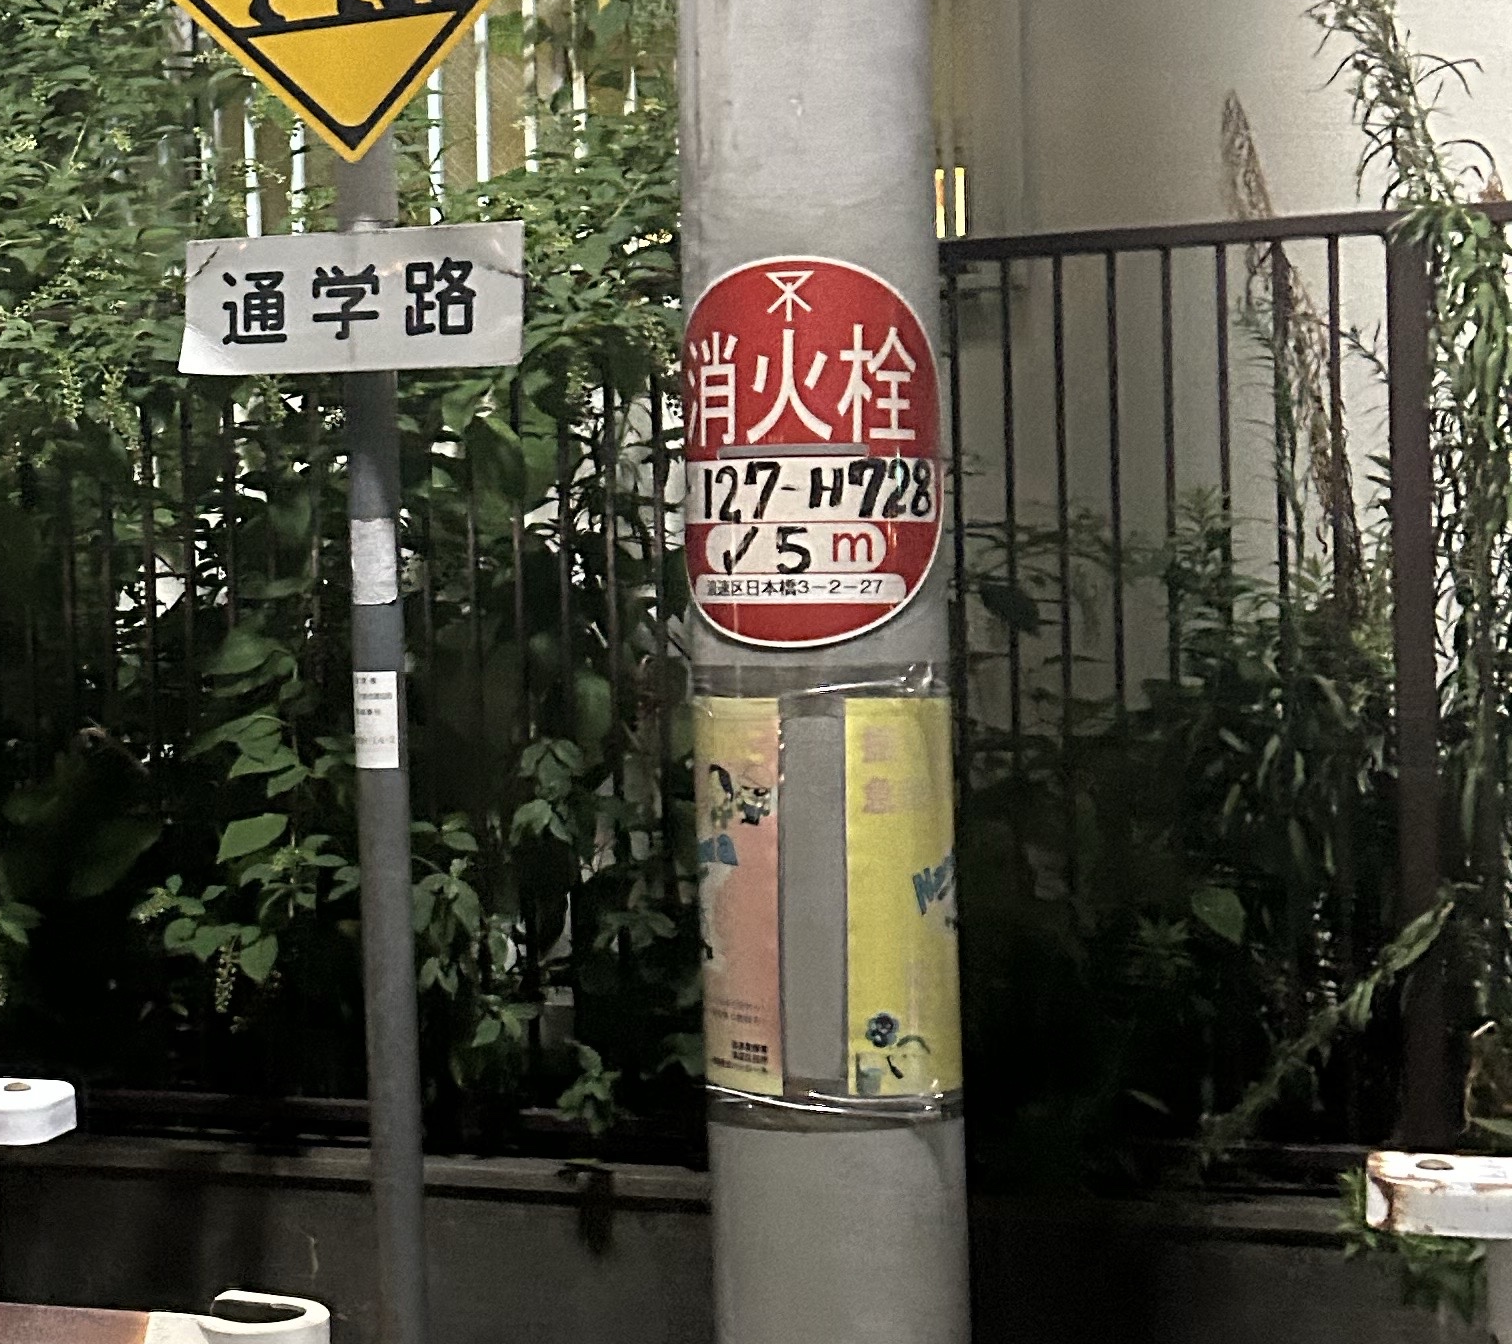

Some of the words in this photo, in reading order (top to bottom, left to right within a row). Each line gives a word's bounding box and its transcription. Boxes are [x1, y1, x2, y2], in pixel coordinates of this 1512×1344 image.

[222, 256, 477, 345] 通学路
[687, 323, 917, 448] 消火栓
[832, 531, 874, 563] m
